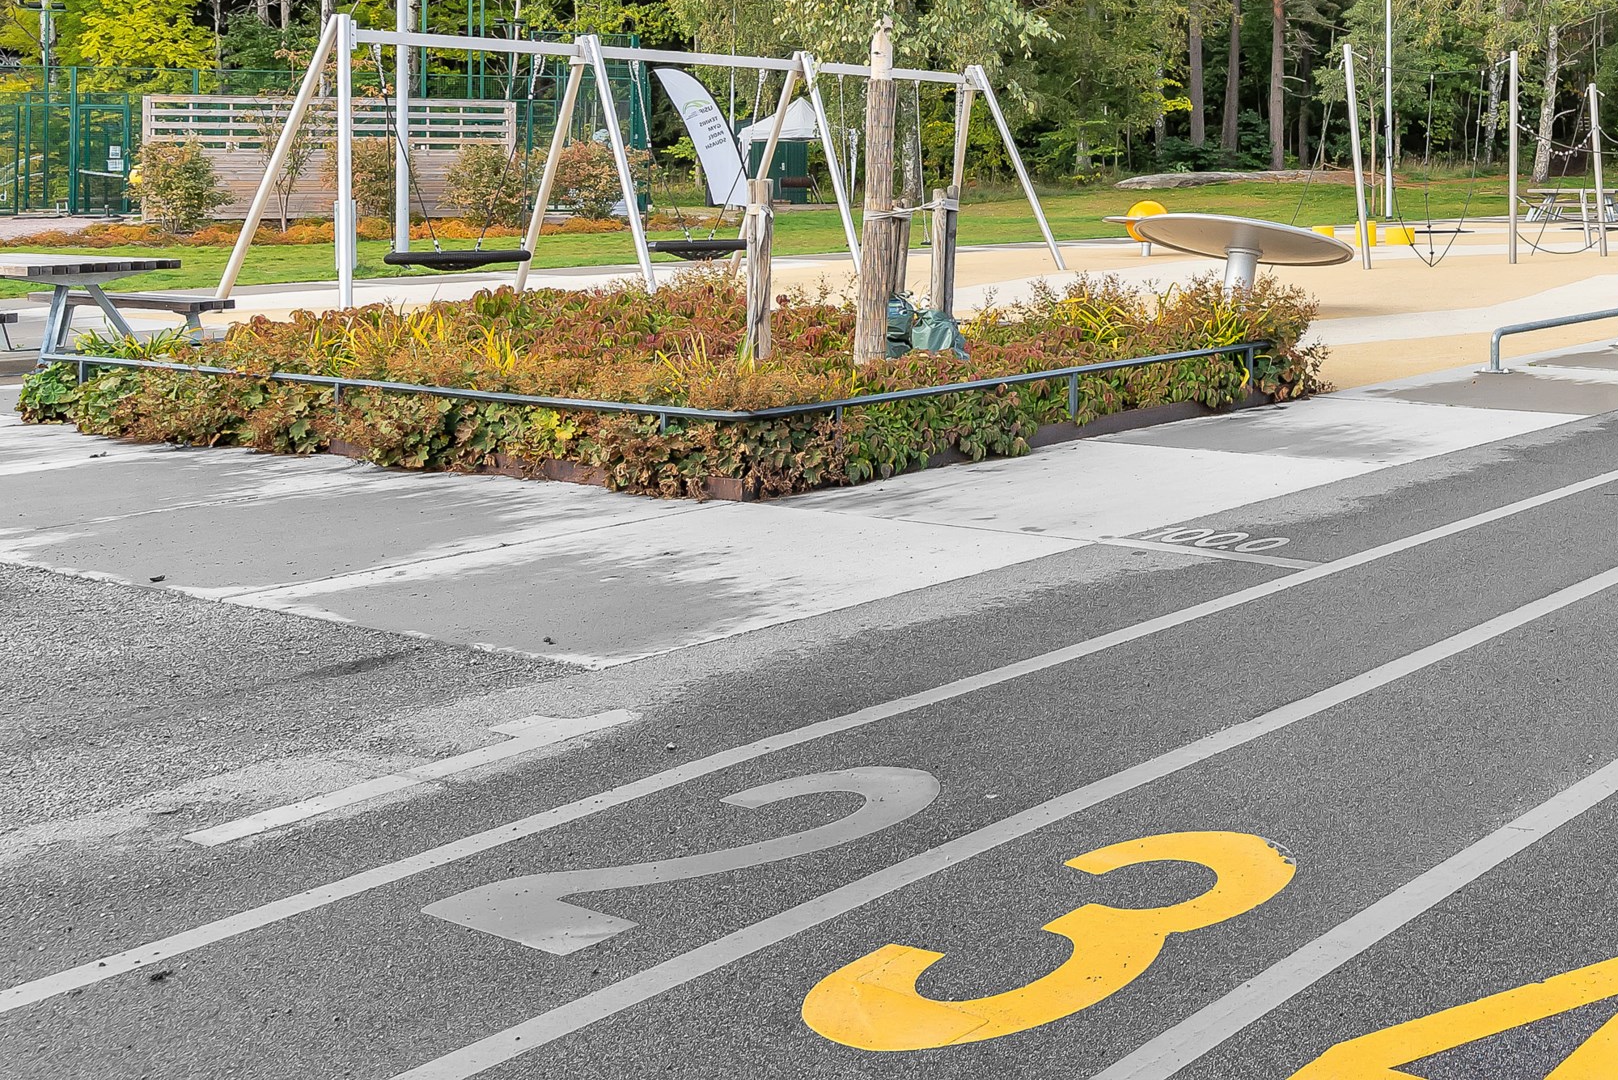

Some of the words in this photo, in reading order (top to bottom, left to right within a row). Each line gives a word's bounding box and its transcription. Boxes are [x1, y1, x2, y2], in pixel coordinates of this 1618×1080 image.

[182, 708, 641, 847] 1
[420, 766, 941, 955] 2
[801, 831, 1297, 1051] 3
